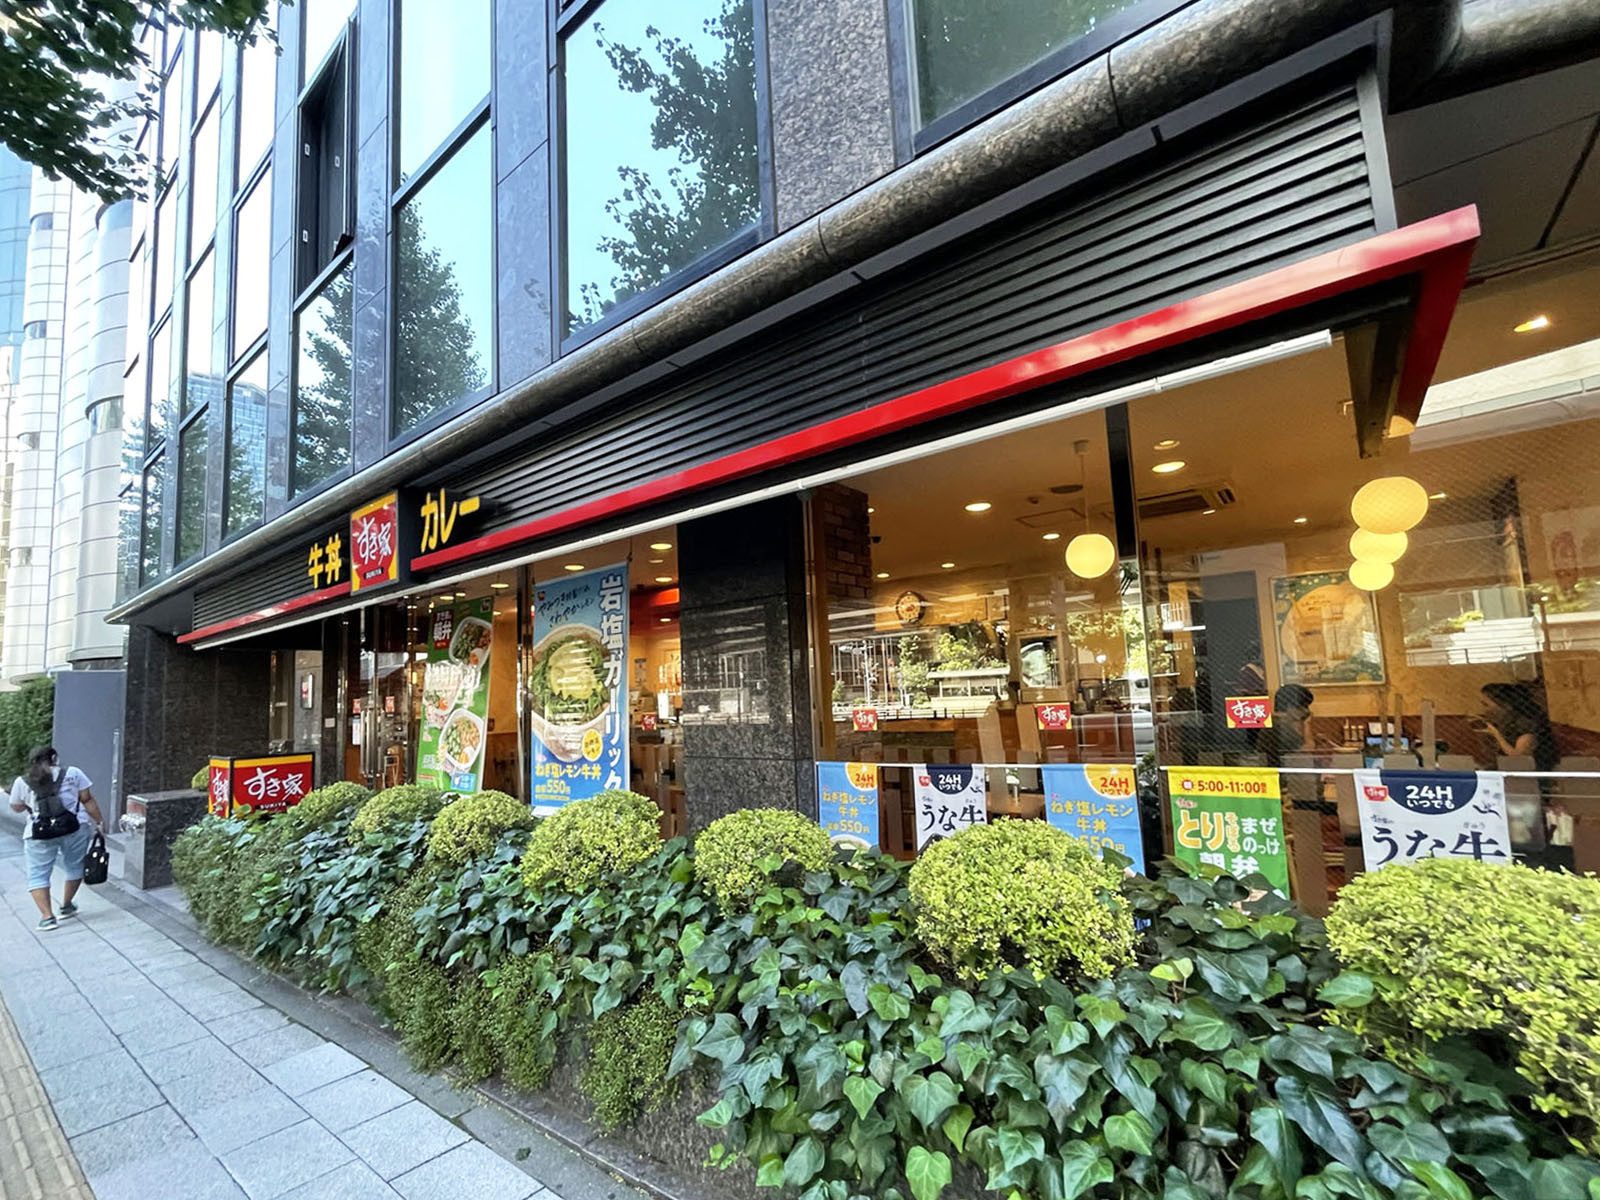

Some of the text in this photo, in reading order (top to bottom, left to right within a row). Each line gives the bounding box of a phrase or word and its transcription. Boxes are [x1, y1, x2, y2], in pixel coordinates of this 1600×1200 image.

[421, 488, 480, 552] カレー
[357, 516, 392, 566] すき家
[308, 532, 342, 589] 牛丼
[600, 575, 624, 790] 岩塩ガーリック
[1041, 705, 1068, 722] すき家
[1231, 700, 1267, 720] すき家
[535, 762, 602, 780] ねぎ塩レモン牛丼
[855, 773, 874, 783] 24H
[938, 774, 961, 785] 24H
[243, 767, 304, 801] すき家
[1100, 777, 1129, 788] 24H
[1198, 780, 1261, 794] 5:00-11:00
[823, 791, 876, 805] ねぎ塩レモン
[1100, 788, 1131, 796] いつでも
[1405, 785, 1454, 800] 24H
[838, 806, 859, 818] 牛丼
[1051, 800, 1133, 818] ねぎ塩レモン
[1406, 799, 1456, 810] いつでも
[827, 819, 870, 833] 550円
[922, 804, 985, 832] うな牛
[1076, 818, 1107, 834] 牛丼
[1242, 817, 1278, 836] まぜ
[1177, 809, 1225, 851] とり
[1242, 837, 1281, 856] のっけ
[1373, 826, 1508, 865] うな牛
